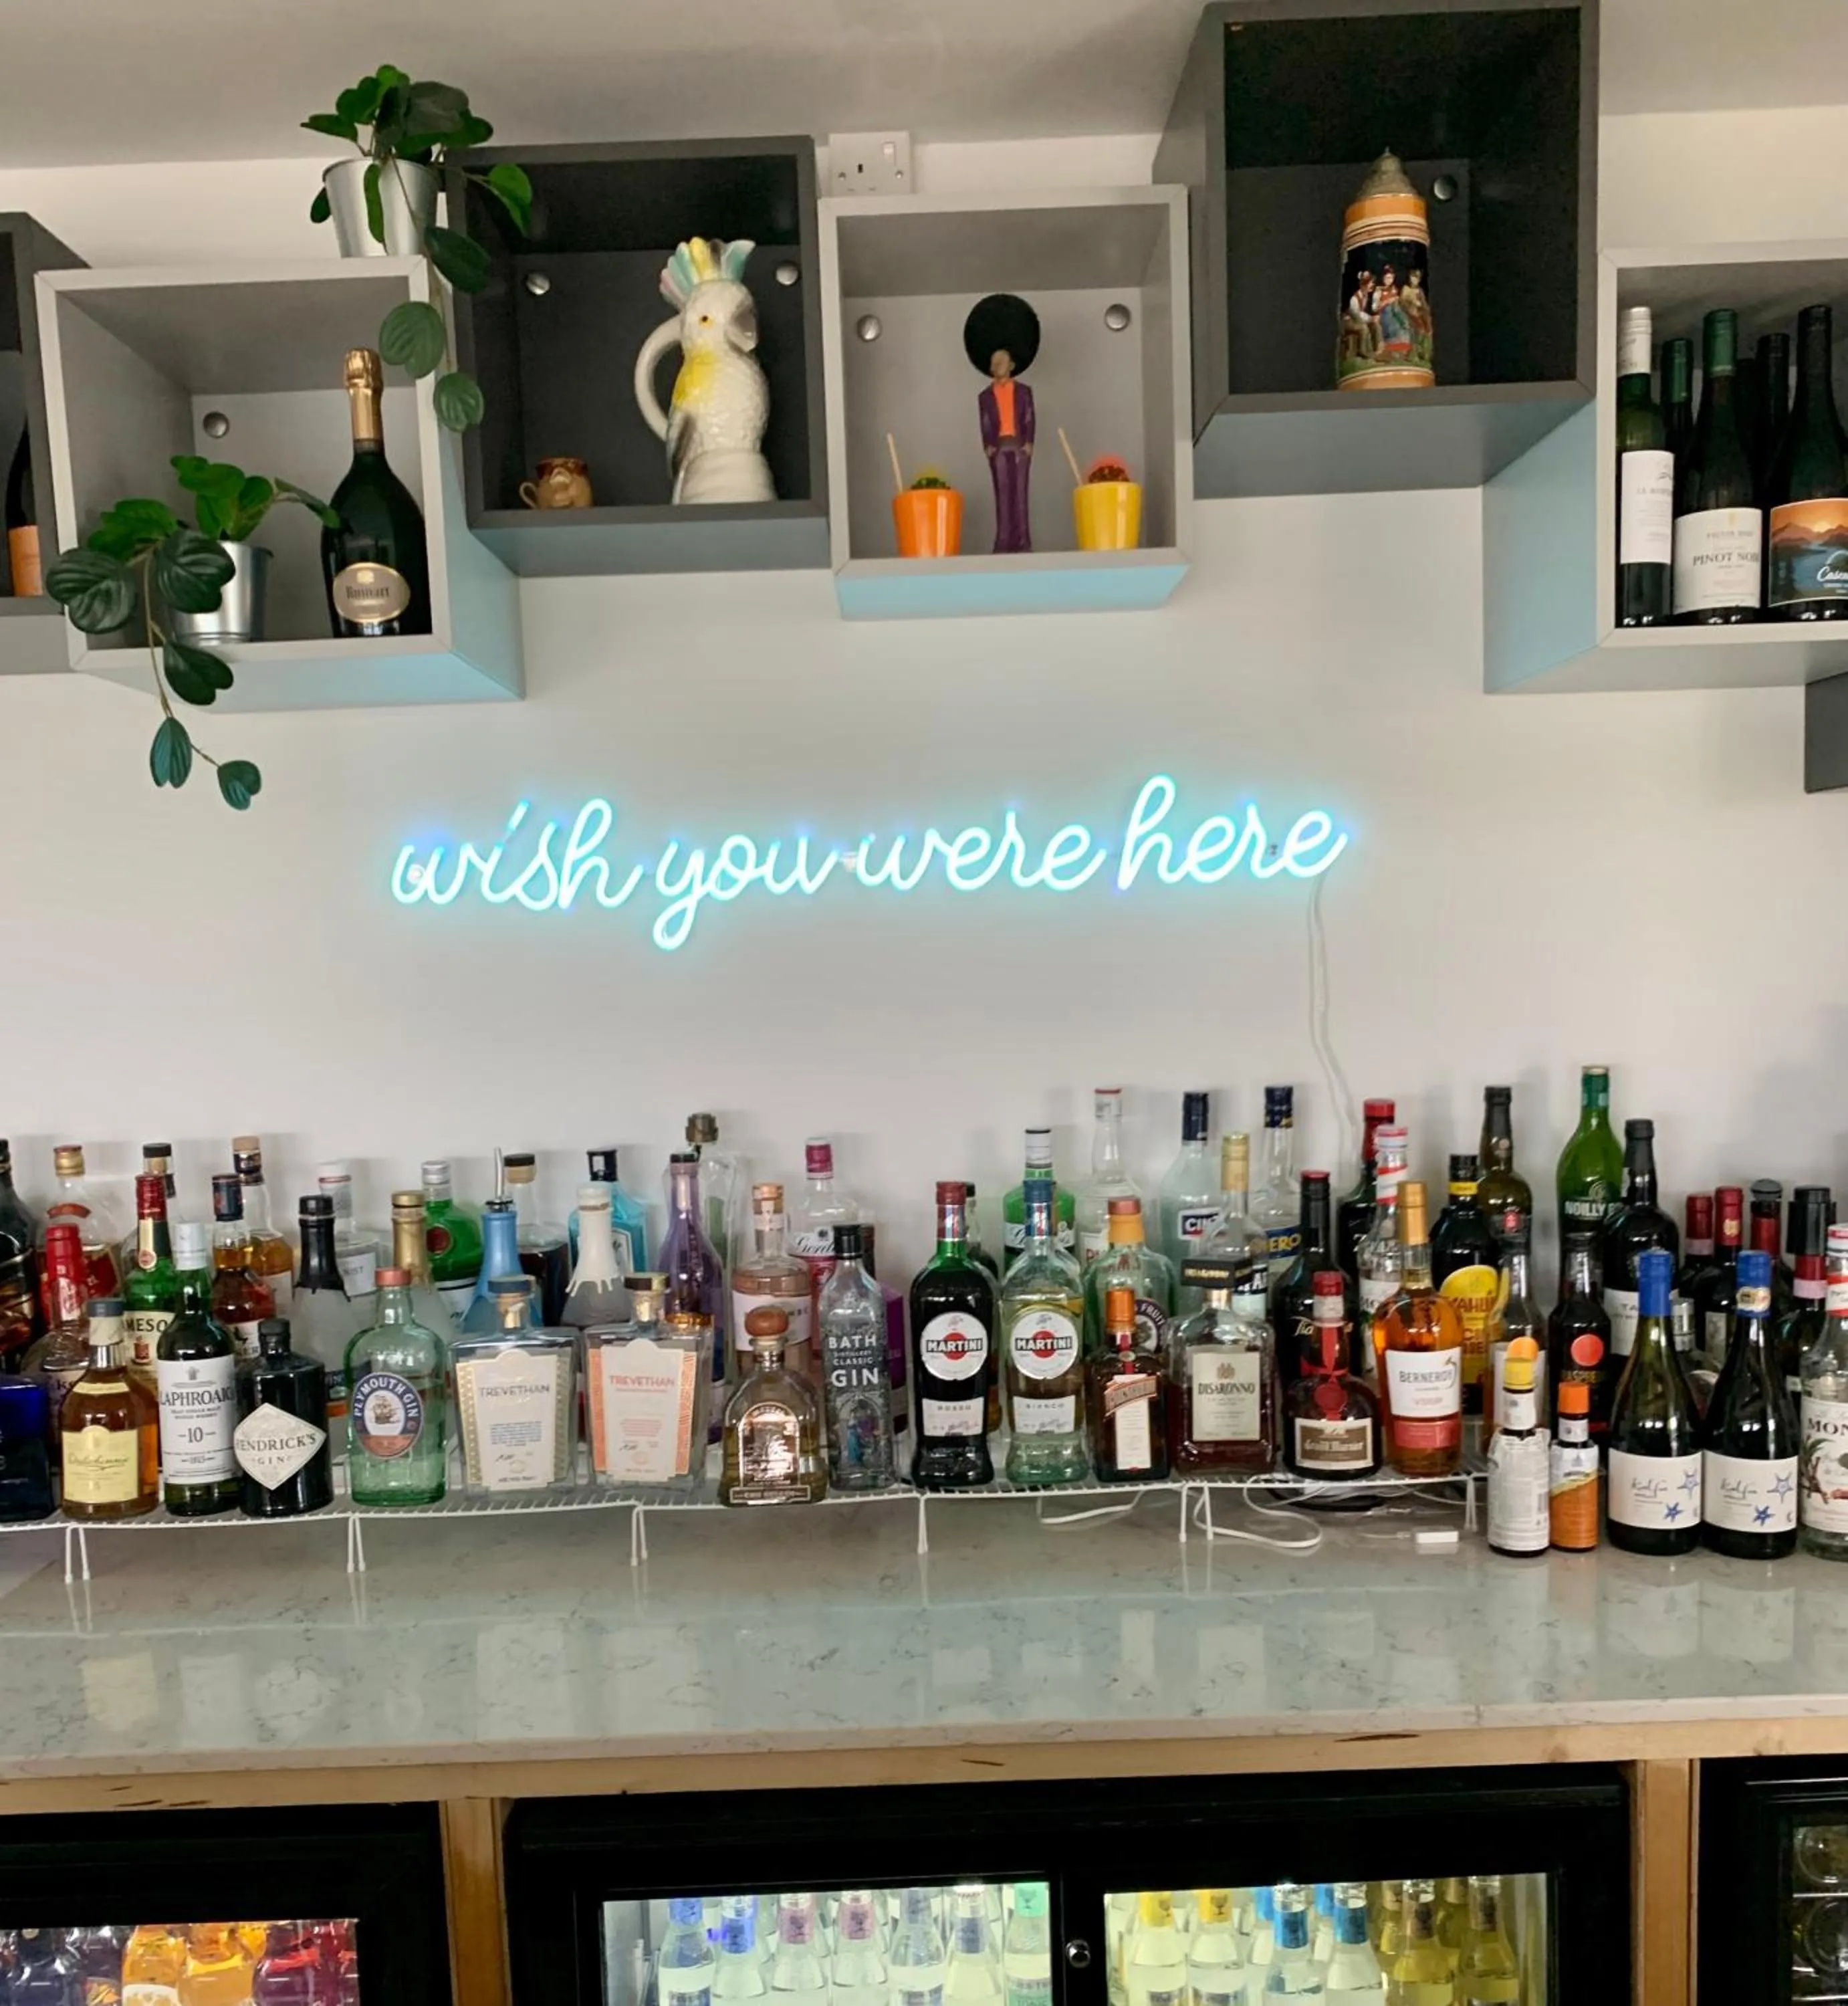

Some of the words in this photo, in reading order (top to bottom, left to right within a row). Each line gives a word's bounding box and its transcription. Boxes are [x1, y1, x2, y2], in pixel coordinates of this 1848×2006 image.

[391, 798, 643, 910] wish
[653, 829, 840, 949] you
[852, 807, 1107, 892] were
[1116, 774, 1349, 890] here
[828, 1334, 877, 1349] BATH
[927, 1339, 982, 1352] MARTINI
[1016, 1337, 1072, 1351] MARTINI
[831, 1367, 879, 1387] GIN
[354, 1377, 407, 1417] PLYMOUTH
[402, 1393, 419, 1418] GIN
[188, 1426, 204, 1443] 10
[1808, 1418, 1848, 1436] MON
